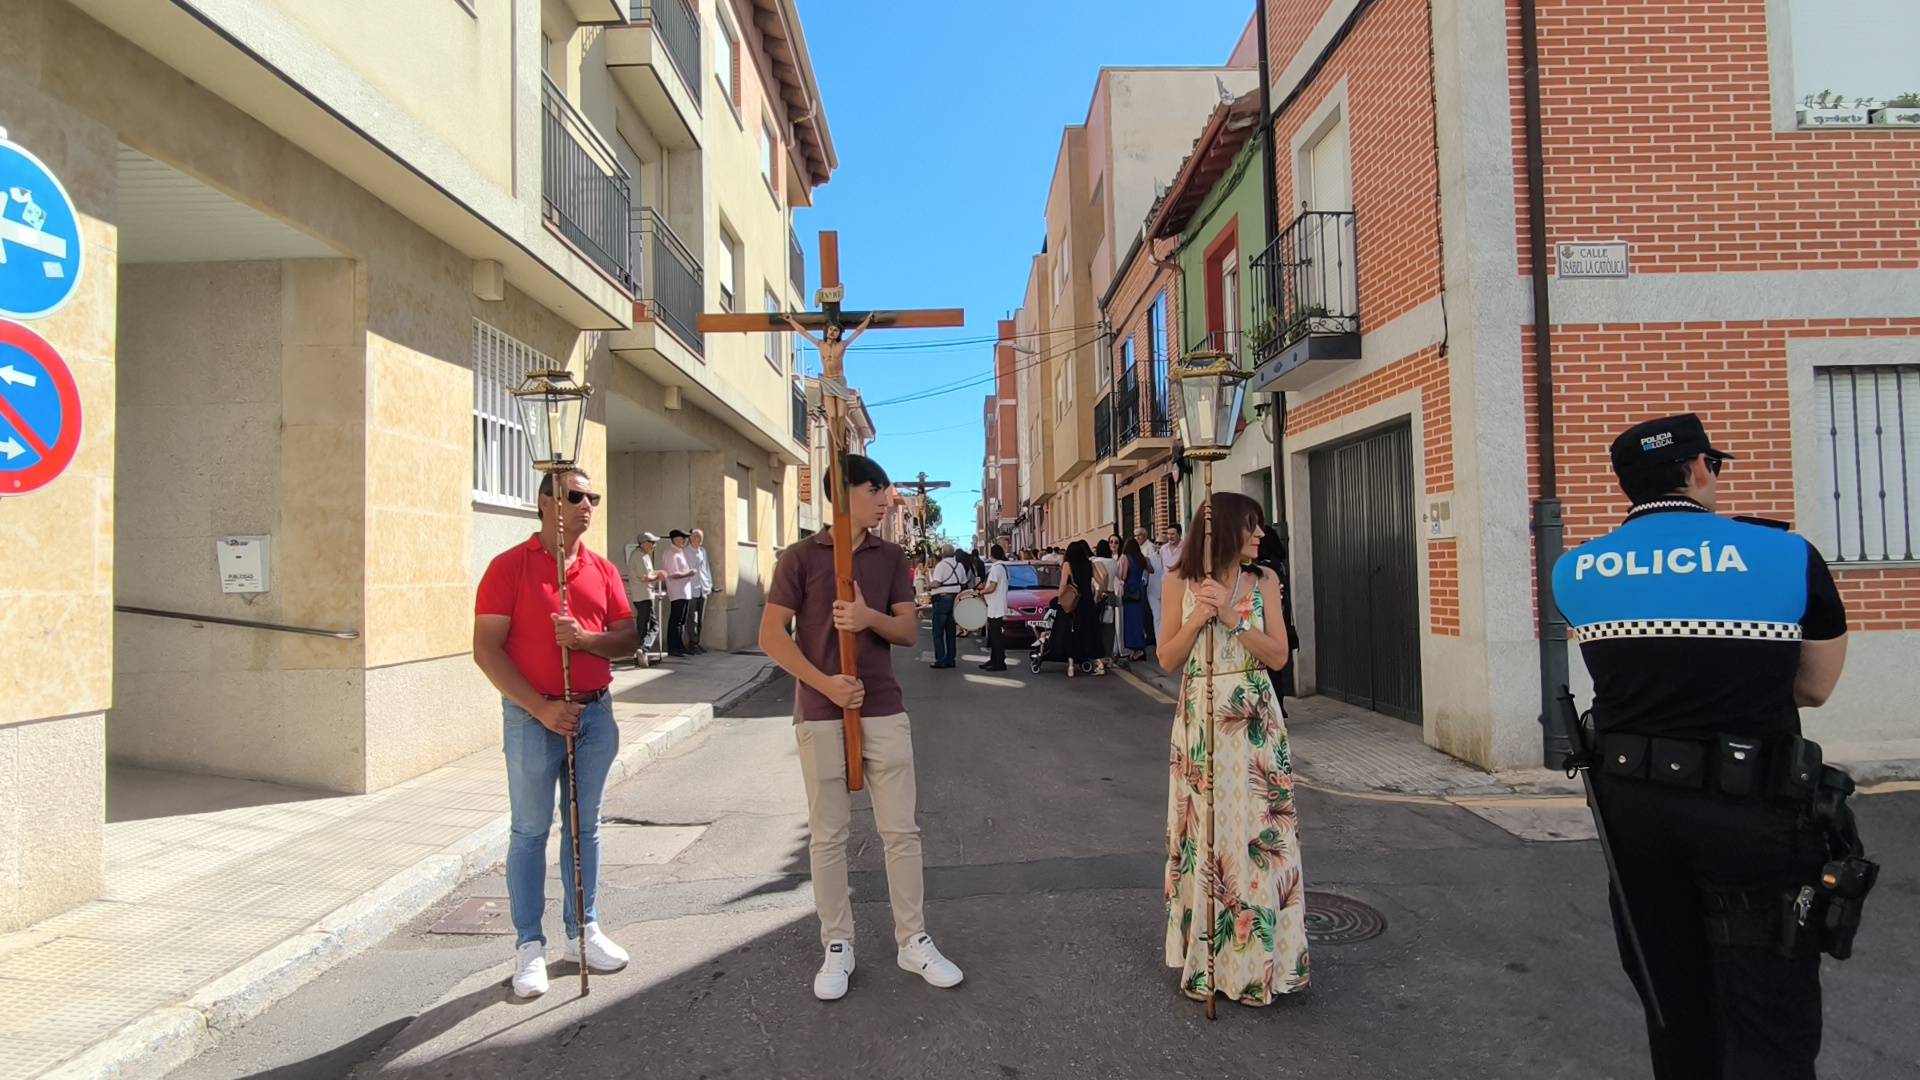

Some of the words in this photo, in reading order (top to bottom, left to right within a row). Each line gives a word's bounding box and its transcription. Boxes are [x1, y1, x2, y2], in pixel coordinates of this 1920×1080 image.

[1580, 248, 1608, 258] CALLE
[1563, 260, 1584, 273] ISABEL
[1585, 260, 1594, 273] LA
[1652, 438, 1674, 449] LOCAL
[1576, 541, 1748, 580] POLICÍA
